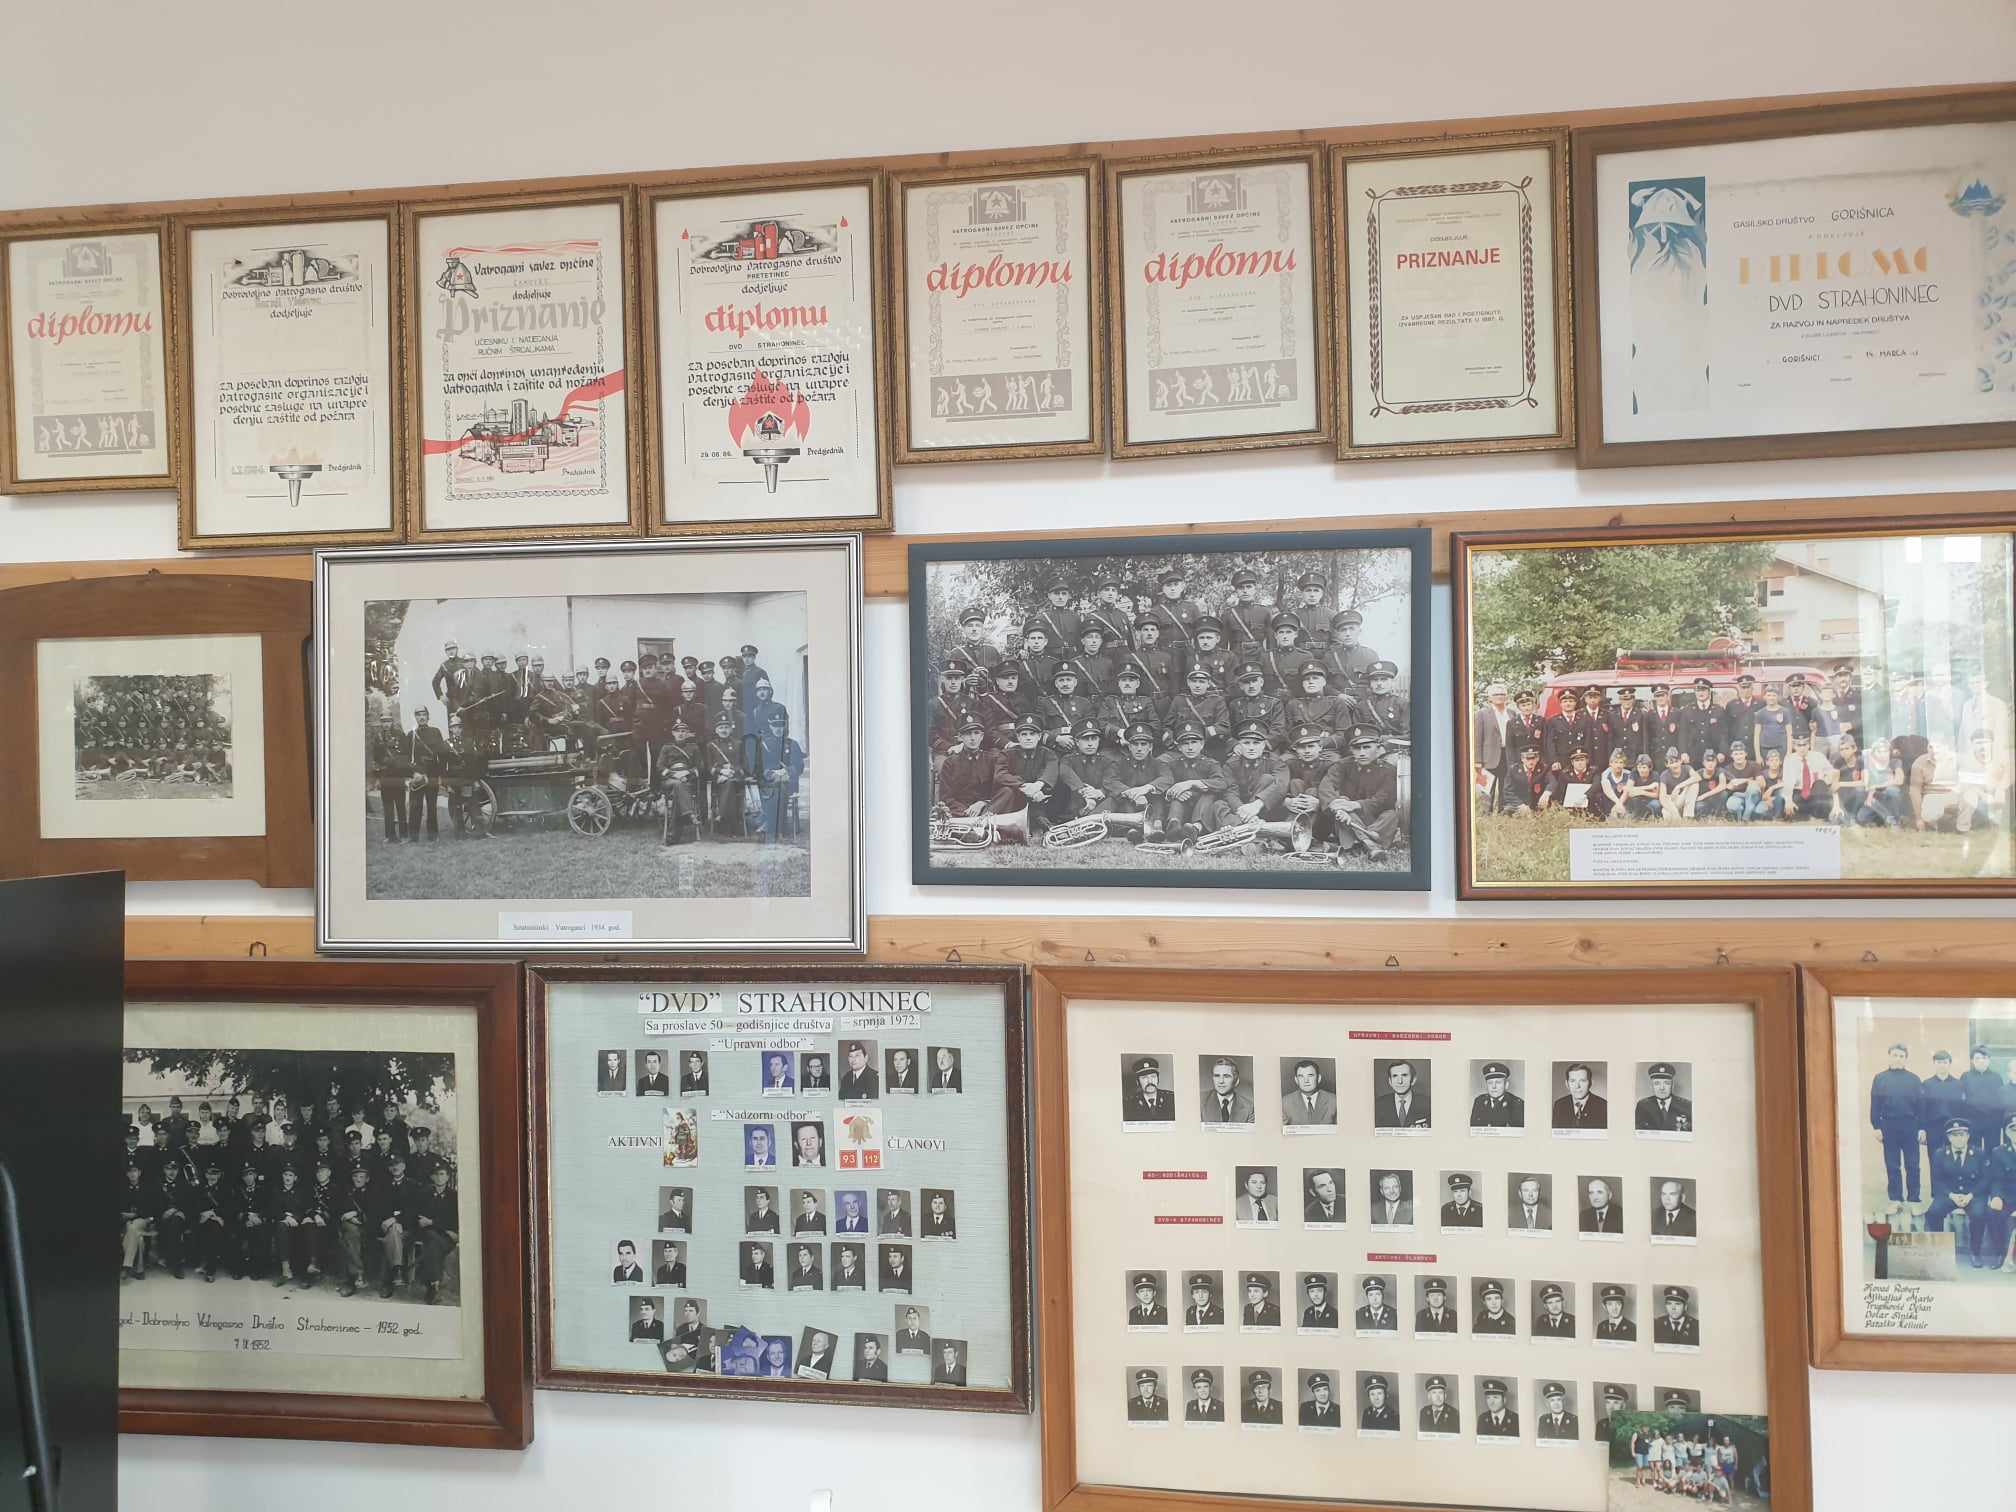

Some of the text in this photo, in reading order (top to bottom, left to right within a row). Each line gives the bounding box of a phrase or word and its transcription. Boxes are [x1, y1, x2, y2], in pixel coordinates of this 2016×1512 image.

[1144, 243, 1297, 289] diplomu
[1397, 248, 1501, 269] PRIZNANJE
[926, 254, 1073, 299] diplomu
[1769, 284, 1940, 312] DVD STRAHONINEC
[27, 305, 152, 345] diplomu
[436, 295, 606, 343] Priznanje
[704, 302, 829, 338] diplomu
[688, 350, 849, 372] za poseban doprinos razvoju
[480, 366, 525, 380] doprinos
[761, 365, 844, 380] organizacije
[237, 379, 282, 392] poseban
[284, 377, 330, 389] doprinos
[549, 379, 562, 390] od
[688, 385, 734, 397] posebne
[737, 382, 781, 395] zasluge
[287, 387, 362, 401] organizacije
[779, 393, 794, 404] od
[219, 403, 262, 415] posebne
[303, 411, 318, 423] od
[739, 990, 930, 1013] STRAHONINEC
[646, 1020, 659, 1031] Sa
[662, 1019, 707, 1035] proslave
[710, 1019, 723, 1031] 50
[736, 1018, 790, 1033] godišnjice
[792, 1018, 831, 1031] društva
[853, 1017, 886, 1030] srpnja
[890, 1015, 918, 1026] 1972.
[608, 1136, 662, 1147] AKTIVNI
[888, 1135, 945, 1151] ČLANOVI
[843, 1156, 856, 1164] 93
[864, 1155, 879, 1164] 112
[377, 1320, 399, 1335] 1952
